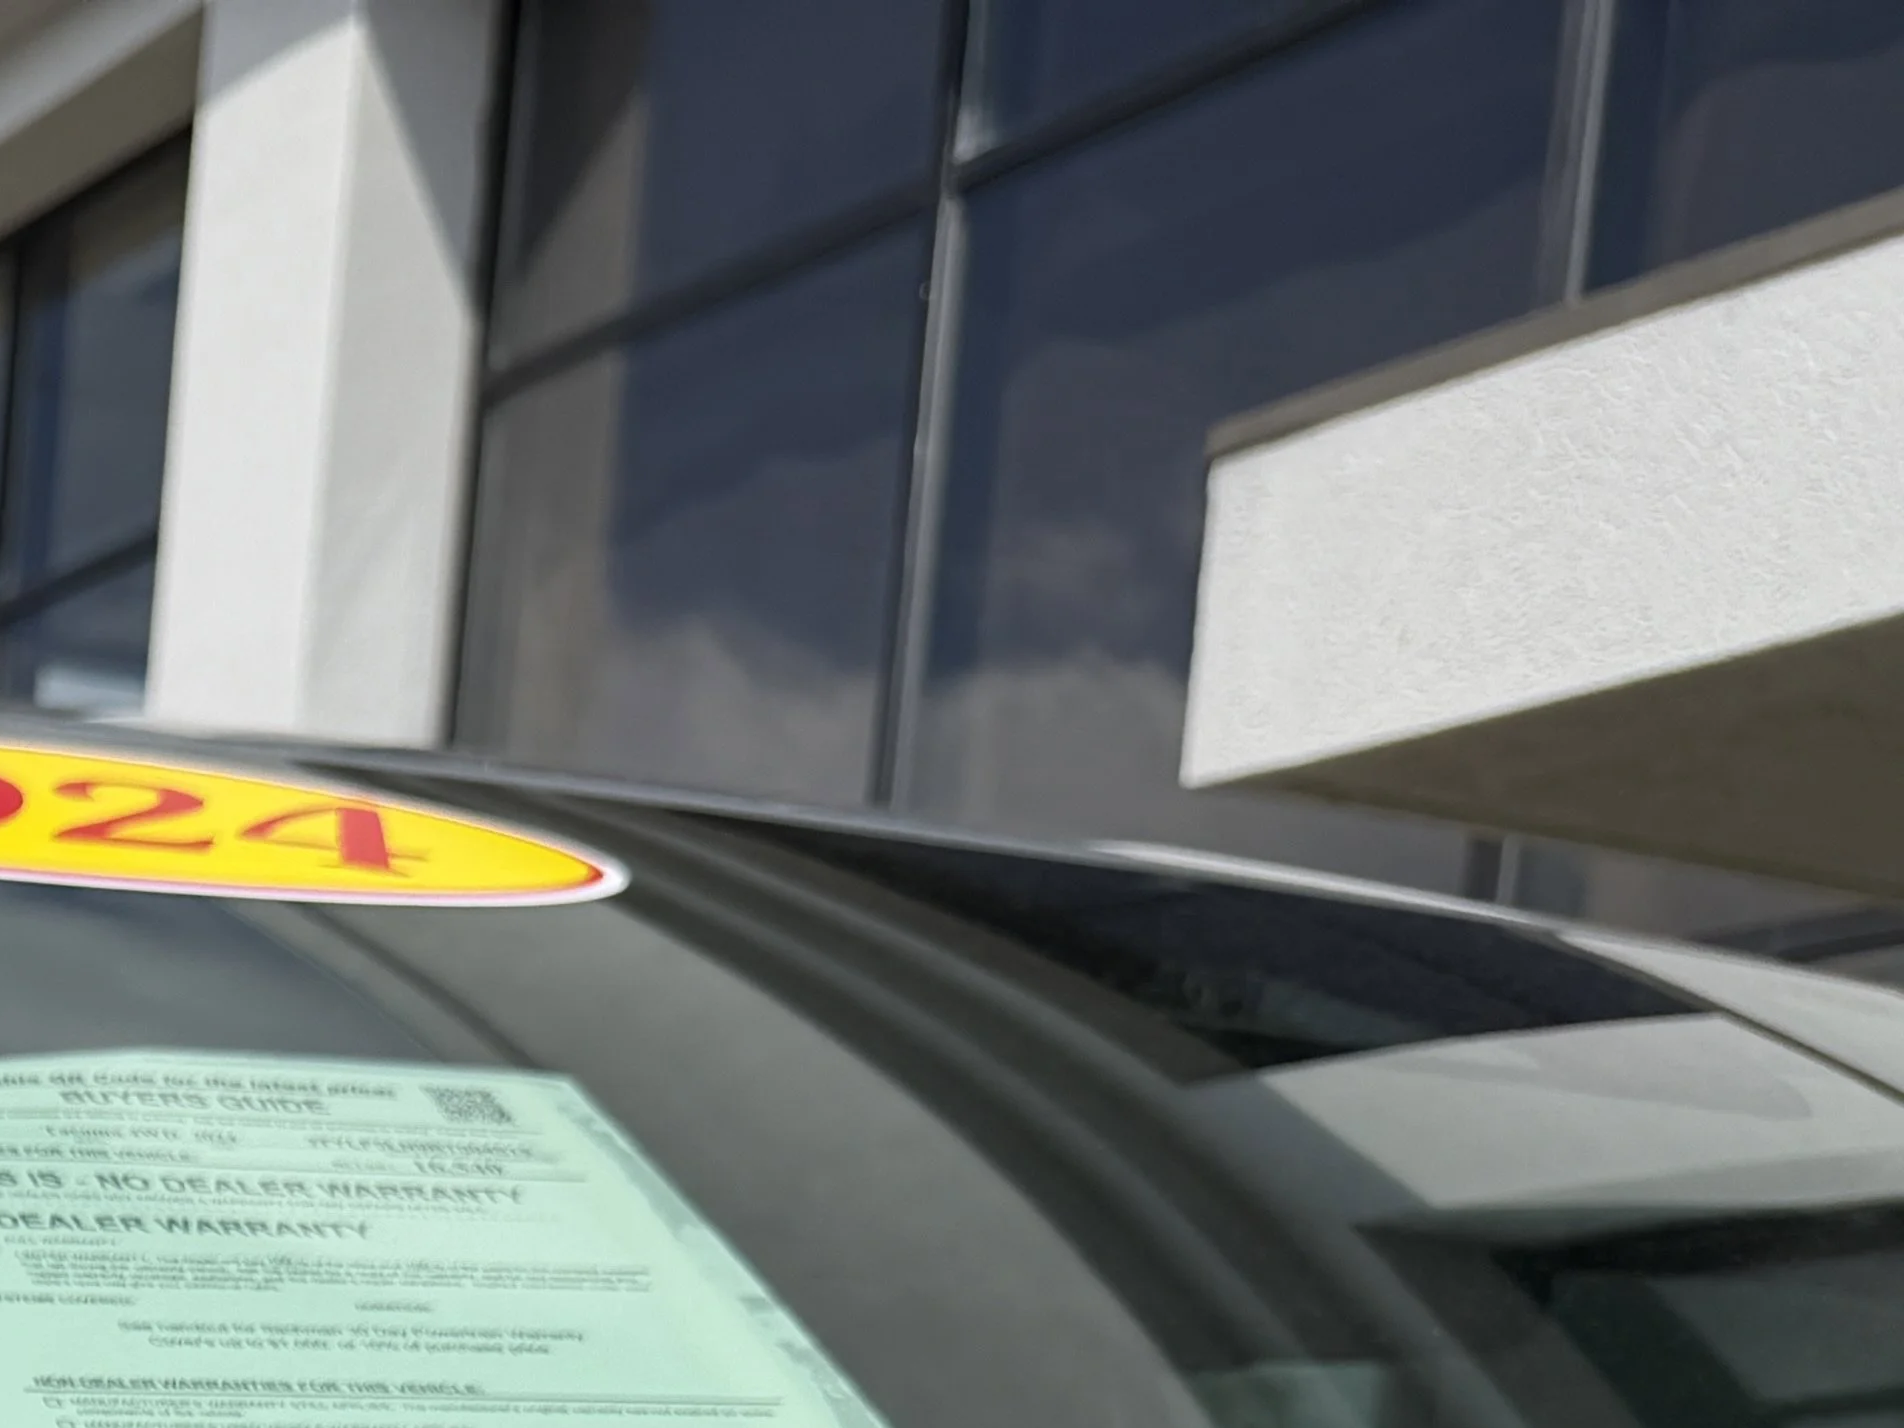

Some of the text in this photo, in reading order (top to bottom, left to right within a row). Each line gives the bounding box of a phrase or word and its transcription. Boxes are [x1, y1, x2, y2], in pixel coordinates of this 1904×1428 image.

[57, 1089, 332, 1116] BUYERS GUIDE
[25, 1168, 64, 1189] IS
[92, 1171, 150, 1192] NO
[157, 1174, 314, 1199] DEALER
[316, 1180, 526, 1205] WARRANTY
[151, 1215, 370, 1239] WARRANTY
